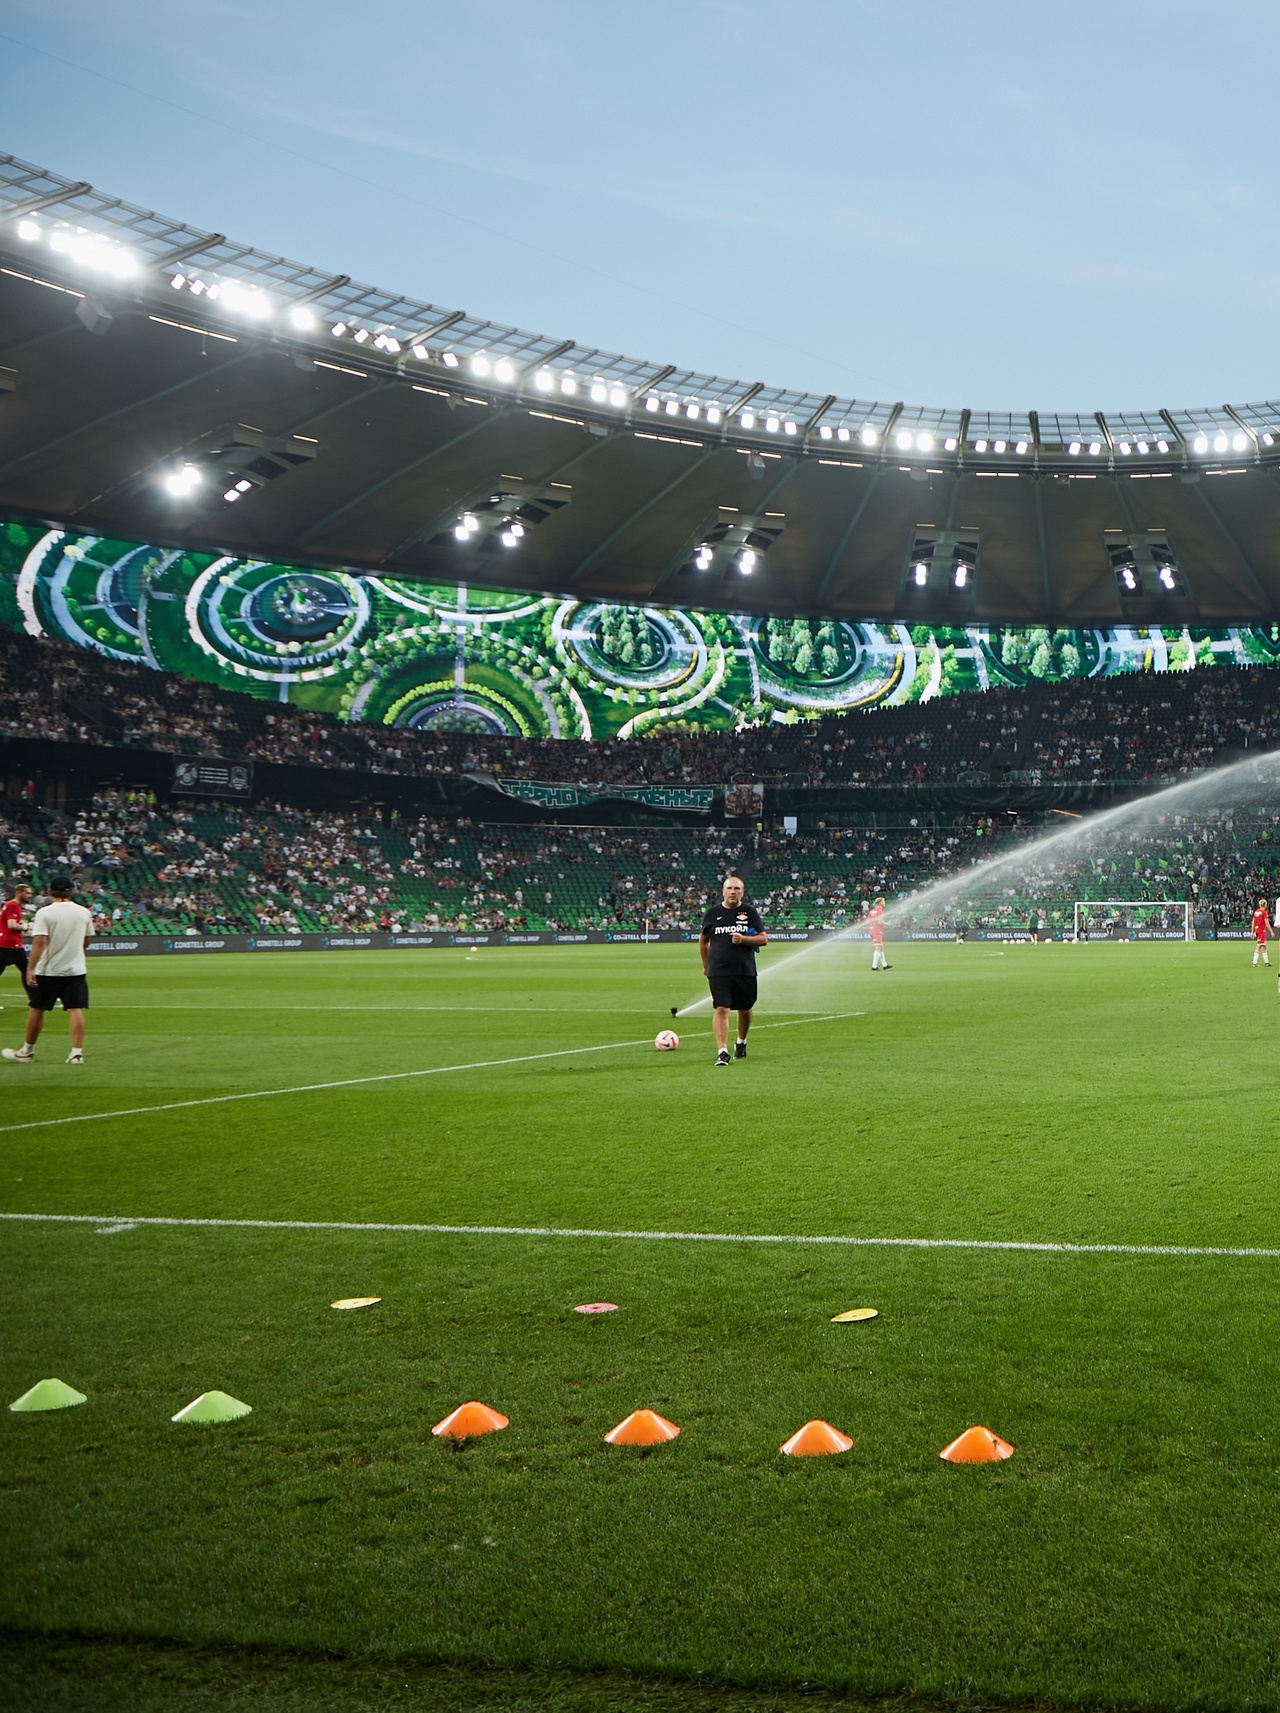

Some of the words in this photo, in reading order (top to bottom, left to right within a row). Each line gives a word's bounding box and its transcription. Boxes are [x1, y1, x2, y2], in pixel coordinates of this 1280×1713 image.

[714, 924, 749, 935] ЛУКОЙЛ
[115, 942, 139, 950] GROUP
[204, 940, 225, 948] GROUP
